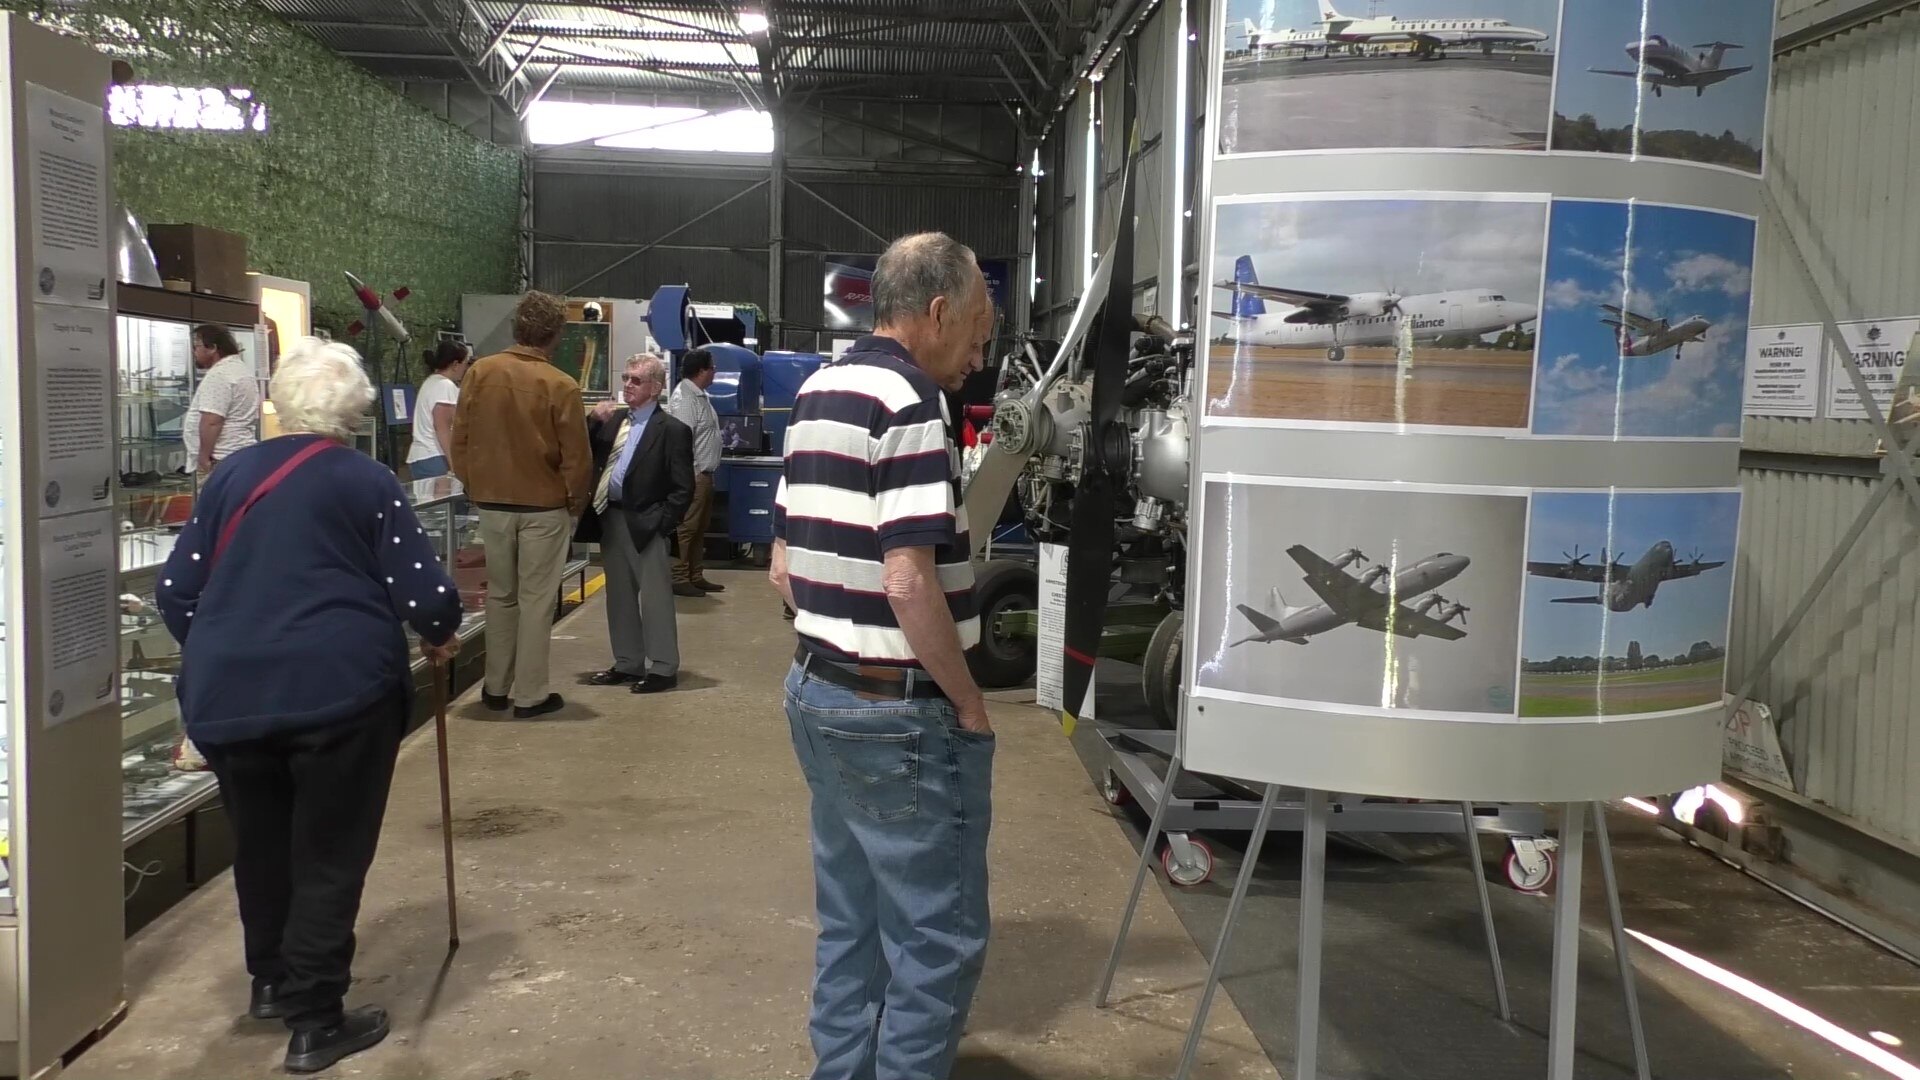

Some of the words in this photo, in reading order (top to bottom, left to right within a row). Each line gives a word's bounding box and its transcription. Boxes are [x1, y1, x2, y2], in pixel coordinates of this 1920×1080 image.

[844, 292, 874, 302] RFD
[1759, 346, 1804, 359] WARNING!
[1849, 350, 1909, 368] ARNING
